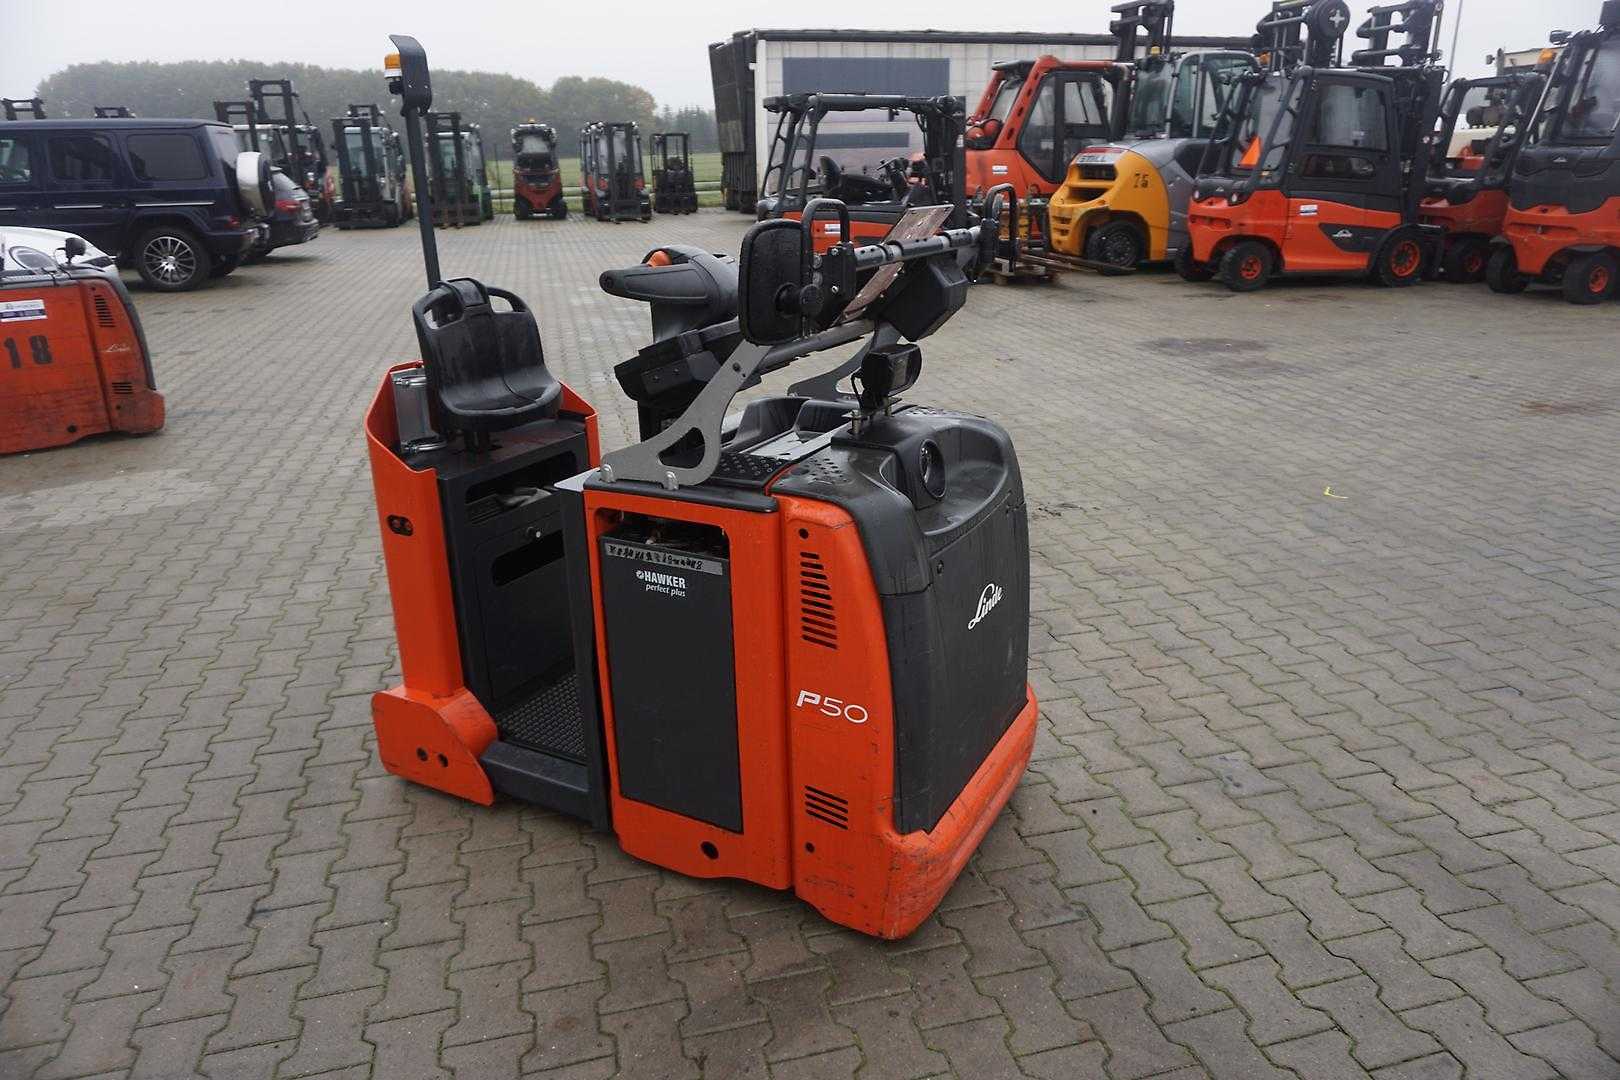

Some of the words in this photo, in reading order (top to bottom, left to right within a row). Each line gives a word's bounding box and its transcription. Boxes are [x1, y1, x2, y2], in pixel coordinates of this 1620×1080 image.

[644, 570, 686, 589] HAWKER
[645, 583, 670, 595] perfect
[670, 588, 686, 597] plus
[967, 583, 1003, 630] Linde
[796, 690, 869, 724] P50
